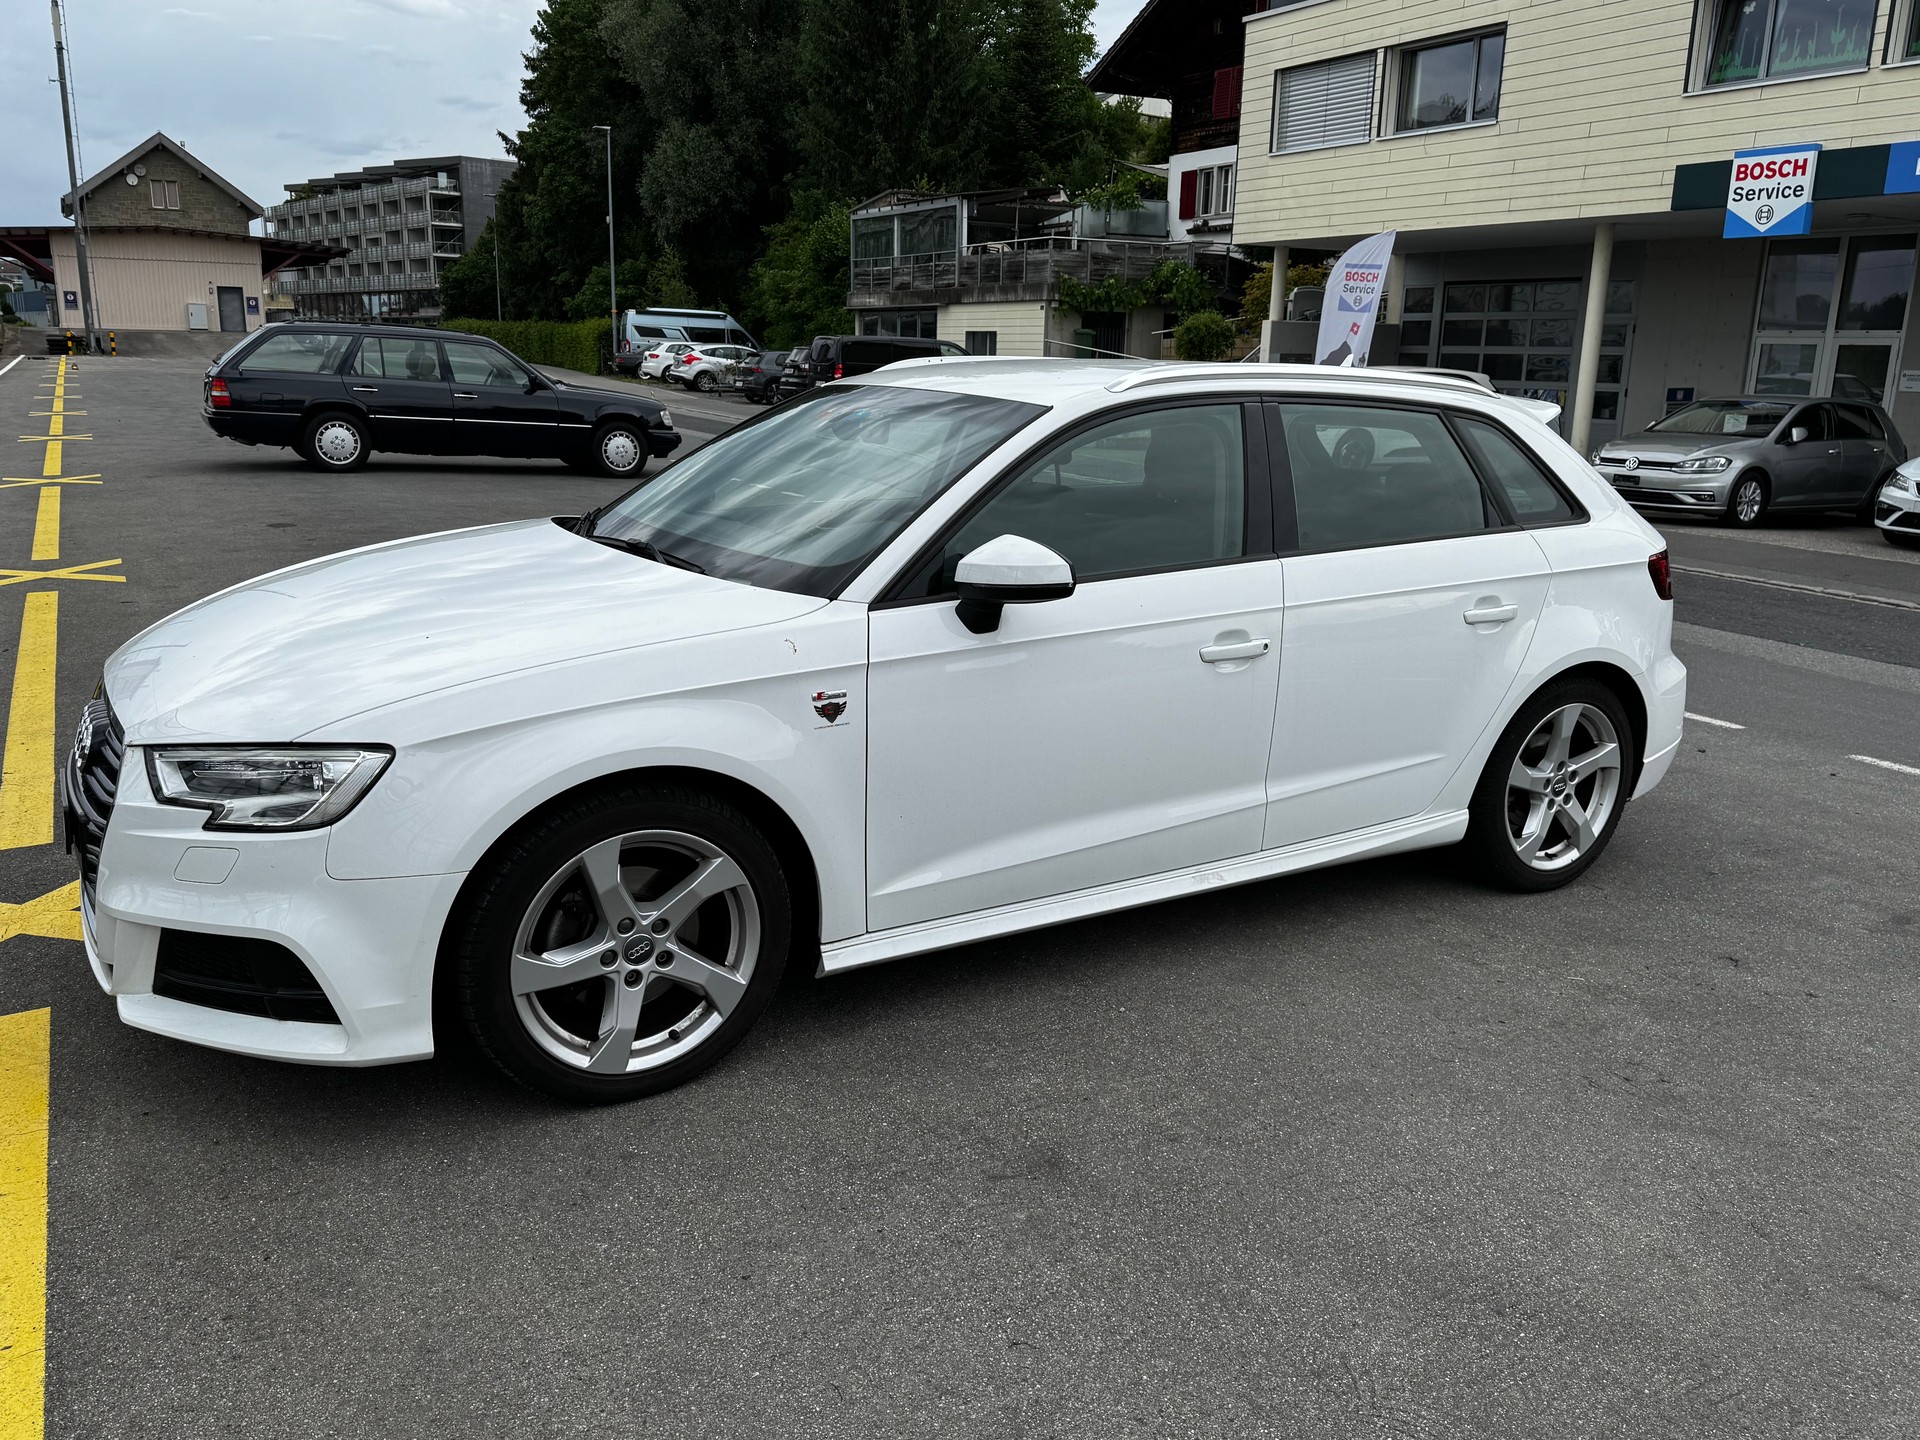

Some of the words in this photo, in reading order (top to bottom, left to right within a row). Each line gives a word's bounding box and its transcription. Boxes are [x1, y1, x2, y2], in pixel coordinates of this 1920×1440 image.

[1735, 158, 1808, 182] BOSCH
[1731, 182, 1805, 203] Service
[1344, 271, 1380, 283] BOSCH
[1342, 283, 1376, 294] Service
